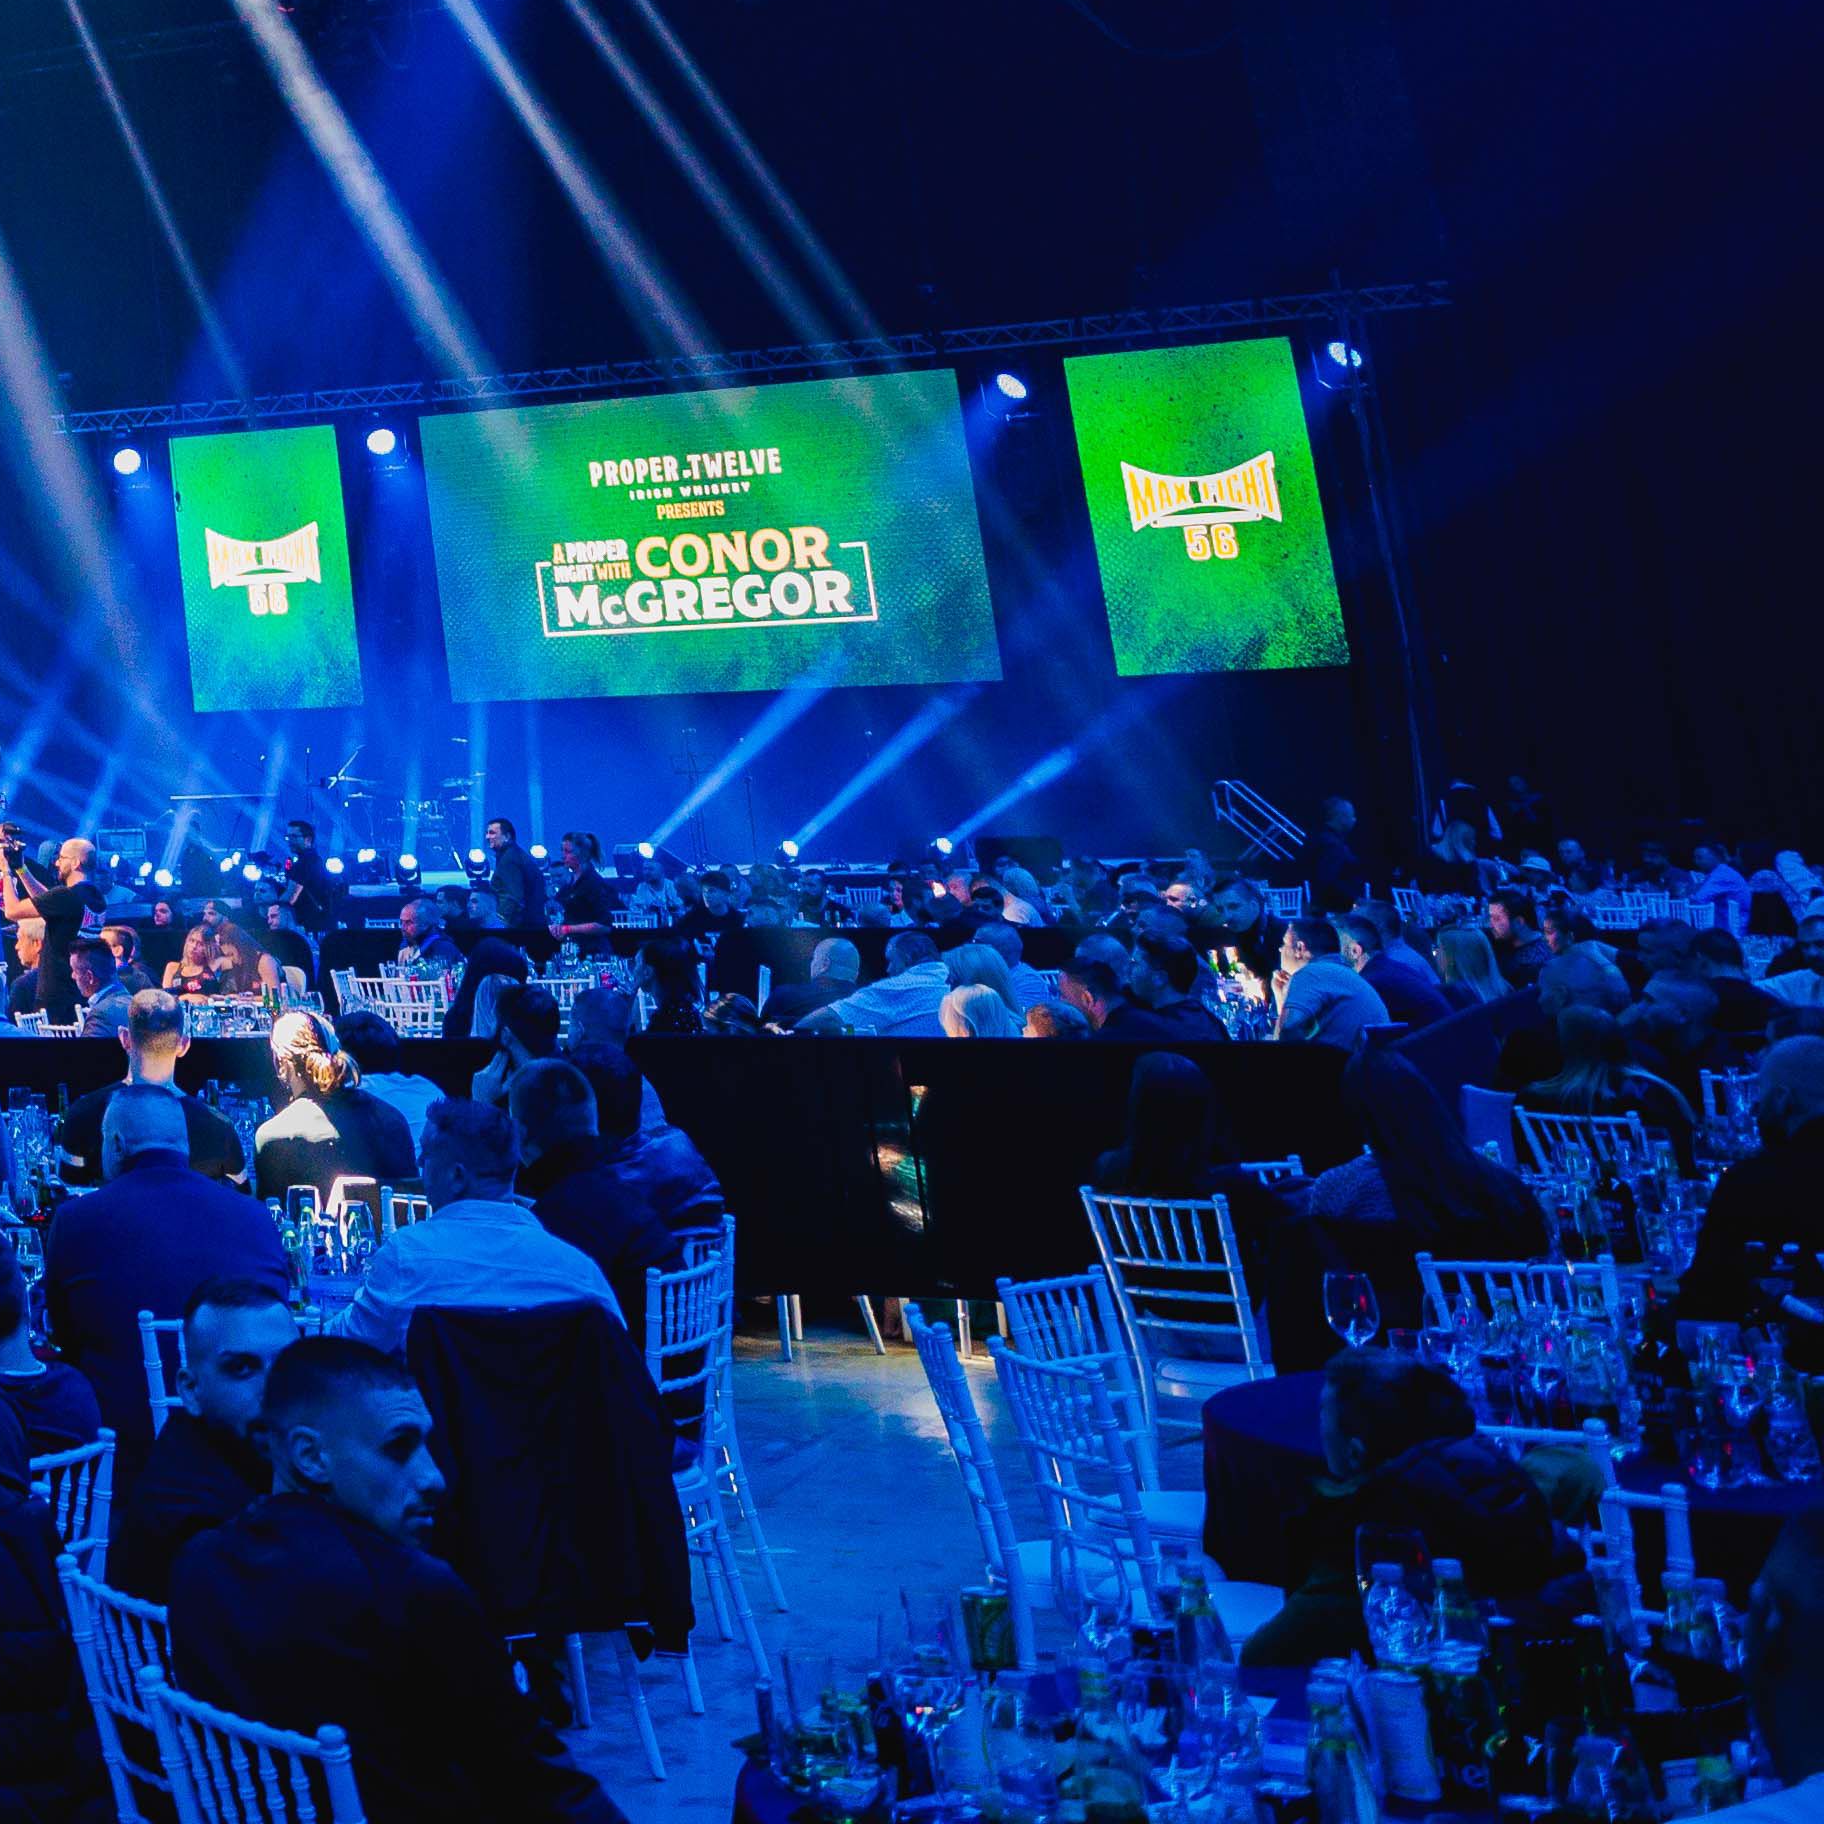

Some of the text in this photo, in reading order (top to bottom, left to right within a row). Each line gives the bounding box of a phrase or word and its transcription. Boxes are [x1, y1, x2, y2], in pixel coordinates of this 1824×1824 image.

[588, 447, 782, 488] PROPER TWELVE
[679, 481, 751, 497] WHISKEY
[1126, 469, 1189, 523] MAX
[656, 499, 725, 520] PRESENTS
[552, 538, 629, 564] A PROPER
[635, 526, 832, 579] CONOR
[1183, 523, 1239, 561] 56
[552, 559, 632, 583] NIGHT WITH
[553, 570, 854, 627] McGREGOR
